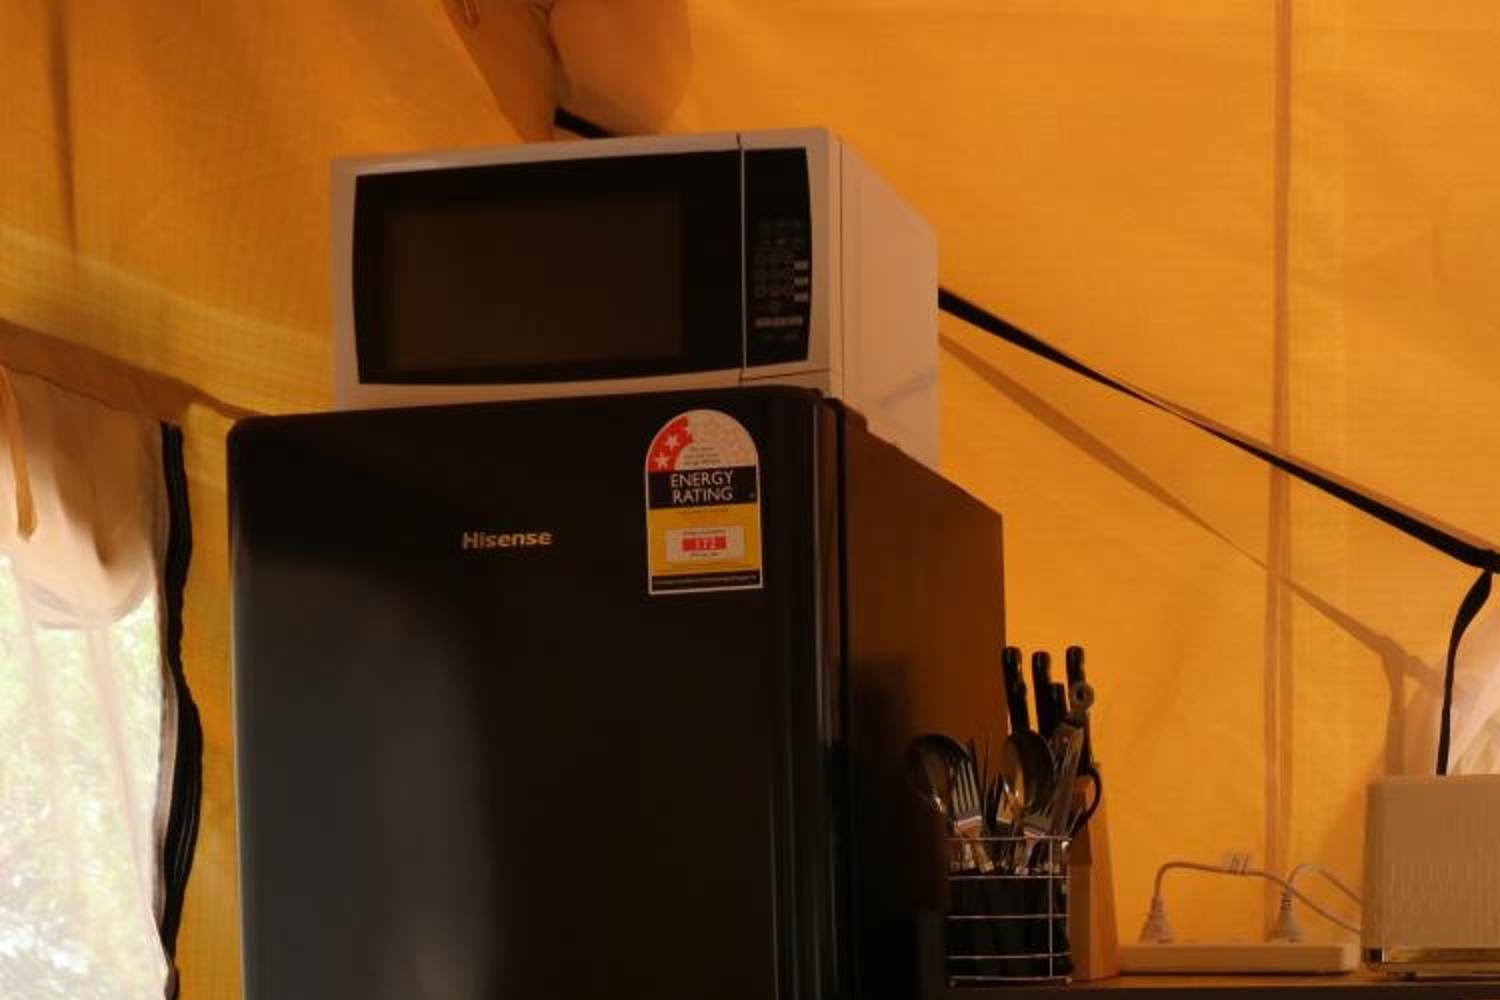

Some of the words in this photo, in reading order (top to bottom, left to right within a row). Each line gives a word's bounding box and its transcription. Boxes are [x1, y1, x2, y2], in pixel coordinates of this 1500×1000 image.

[671, 471, 734, 489] ENERGY
[673, 487, 733, 504] RATING
[463, 531, 552, 549] Hisense
